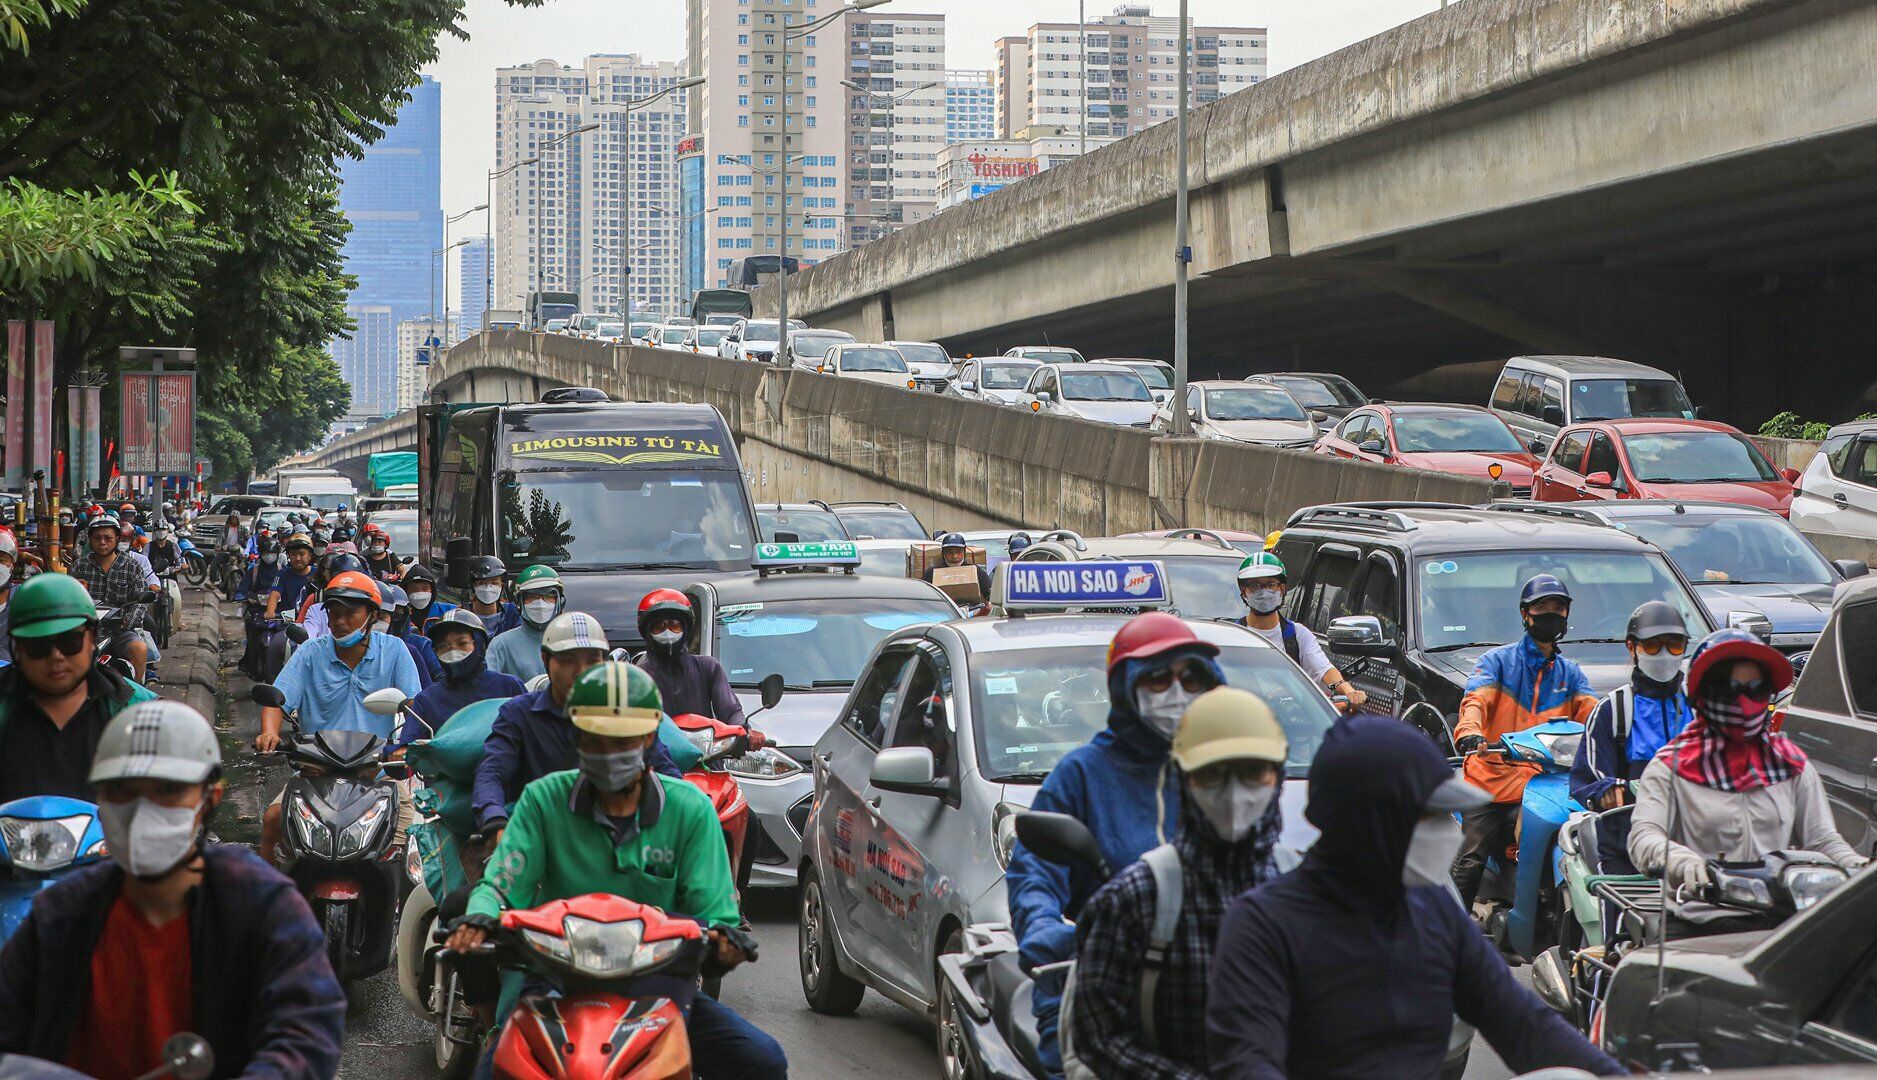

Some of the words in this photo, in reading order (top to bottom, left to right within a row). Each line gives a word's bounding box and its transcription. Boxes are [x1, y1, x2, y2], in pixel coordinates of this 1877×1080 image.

[511, 436, 638, 454] LIMOUSINE
[643, 436, 675, 449] TÚ
[681, 440, 721, 455] TÀI
[787, 544, 806, 552] GV
[818, 543, 853, 552] TAXI
[1014, 570, 1041, 593] HA
[1043, 570, 1077, 593] NOI
[1081, 569, 1118, 593] SAO
[866, 840, 877, 867] HA
[877, 847, 890, 876] NOI
[890, 858, 906, 888] SAO
